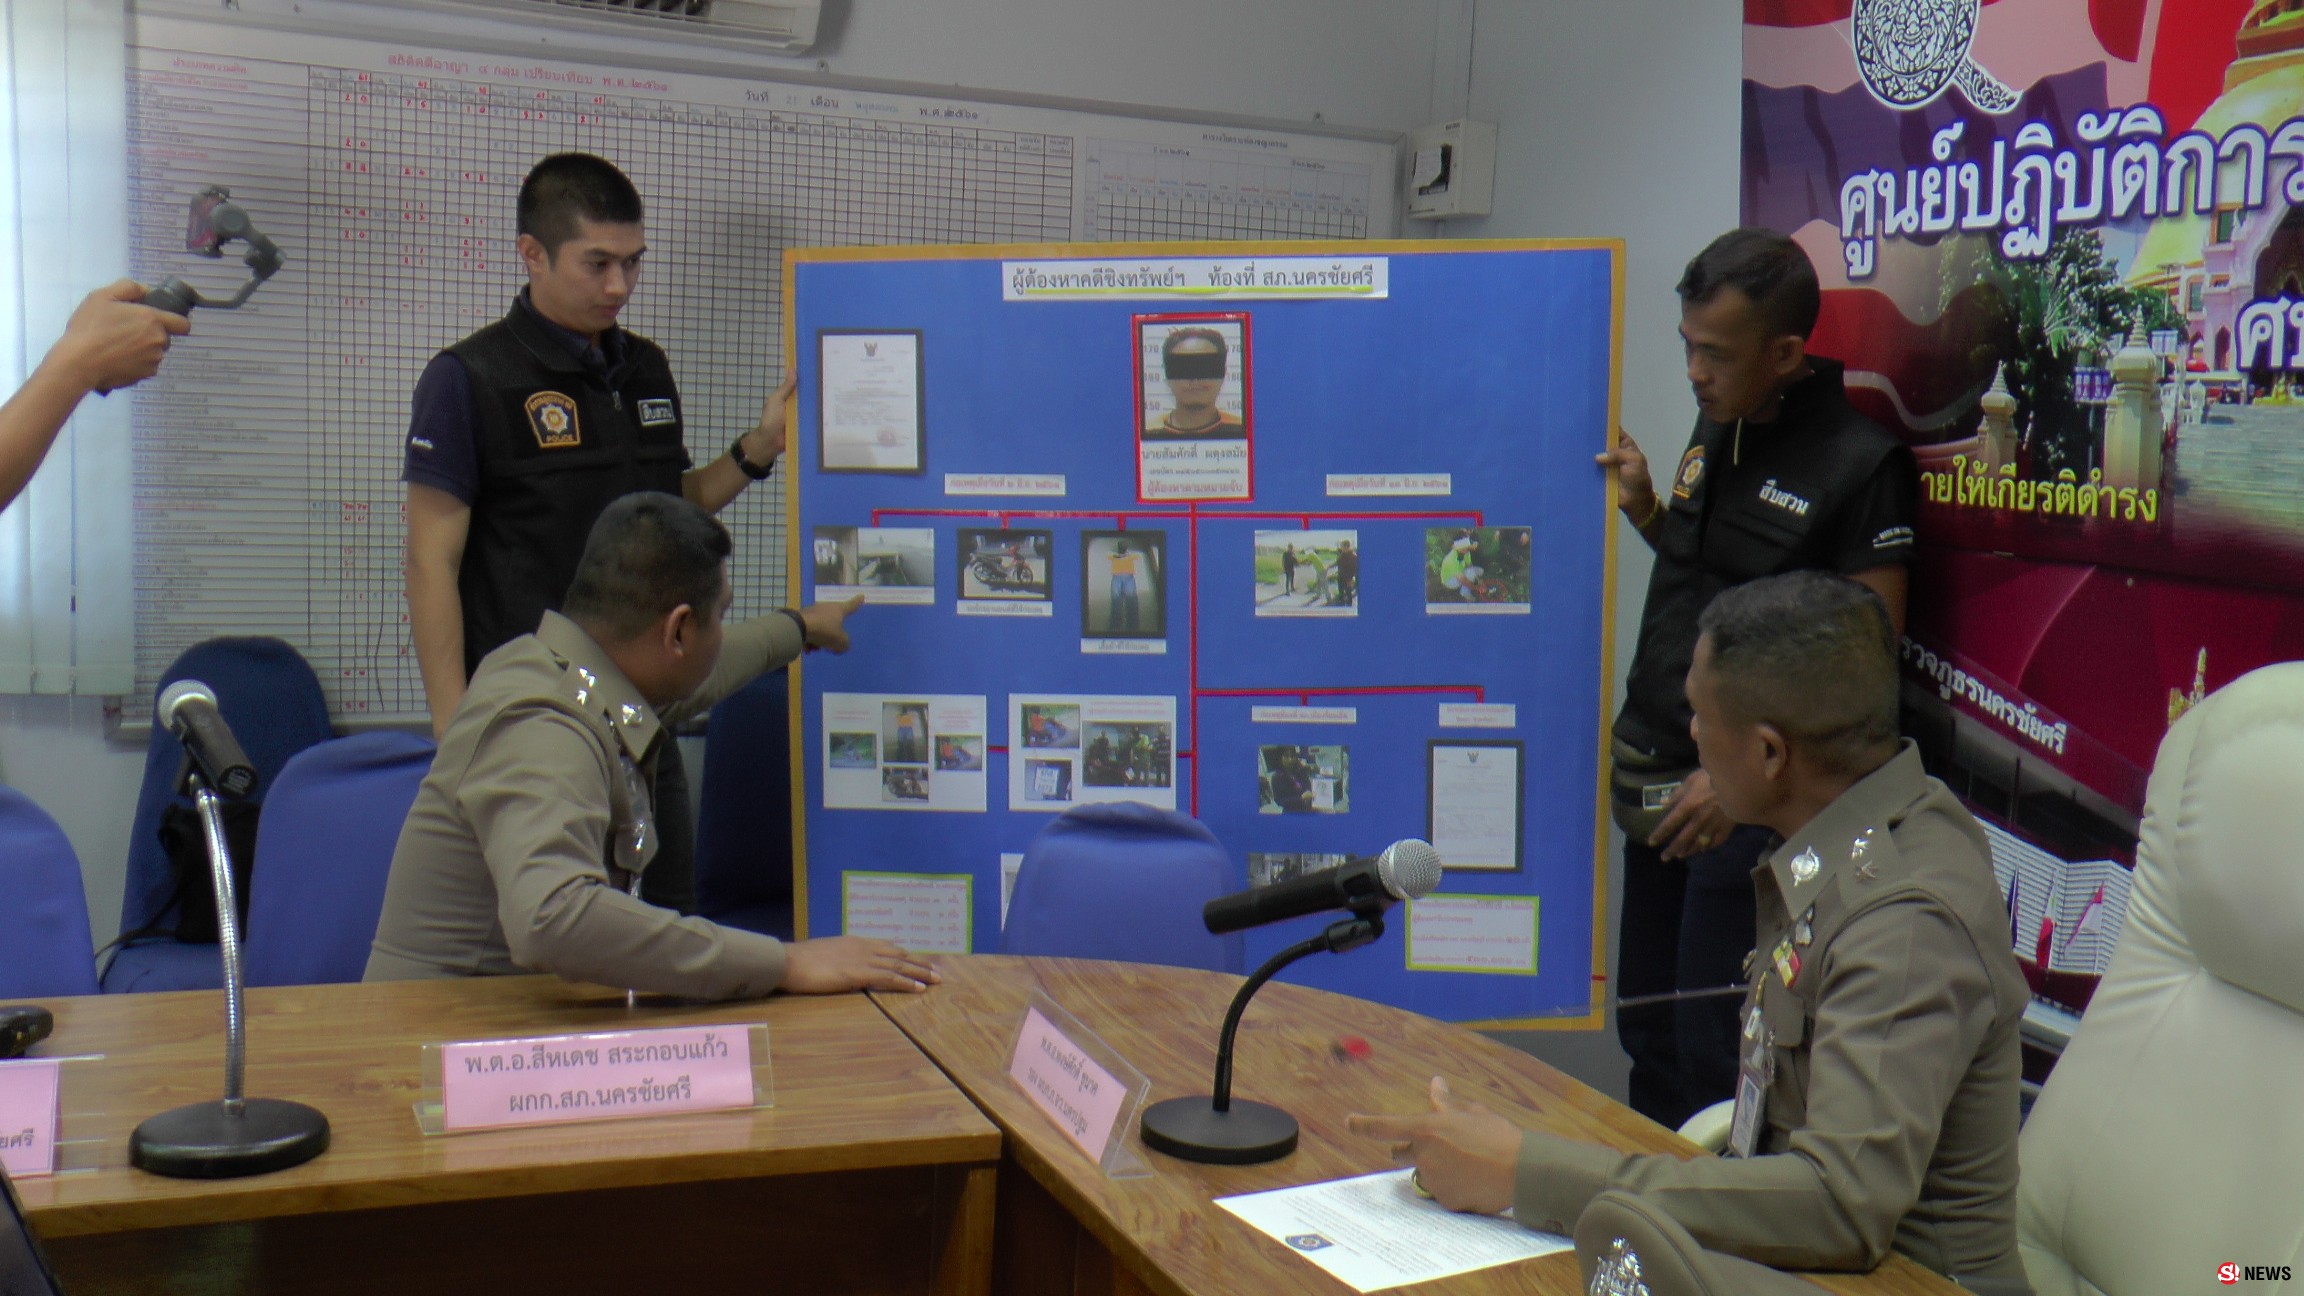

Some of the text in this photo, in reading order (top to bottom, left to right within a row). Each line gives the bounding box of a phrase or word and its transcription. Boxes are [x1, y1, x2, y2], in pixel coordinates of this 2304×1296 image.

[810, 94, 839, 109] เดือน
[1012, 261, 1374, 291] ผู้ต้องหาคดีชิงทรัพย์ฯ ท้องที่ สภ.นครชัยศรี
[1759, 478, 1810, 517] สืบสวน
[465, 1033, 728, 1074] พ.ต.อ.สีหเดช สระกอบแก้ว
[510, 1074, 692, 1113] ผกก.สภ.นครชัยศรี
